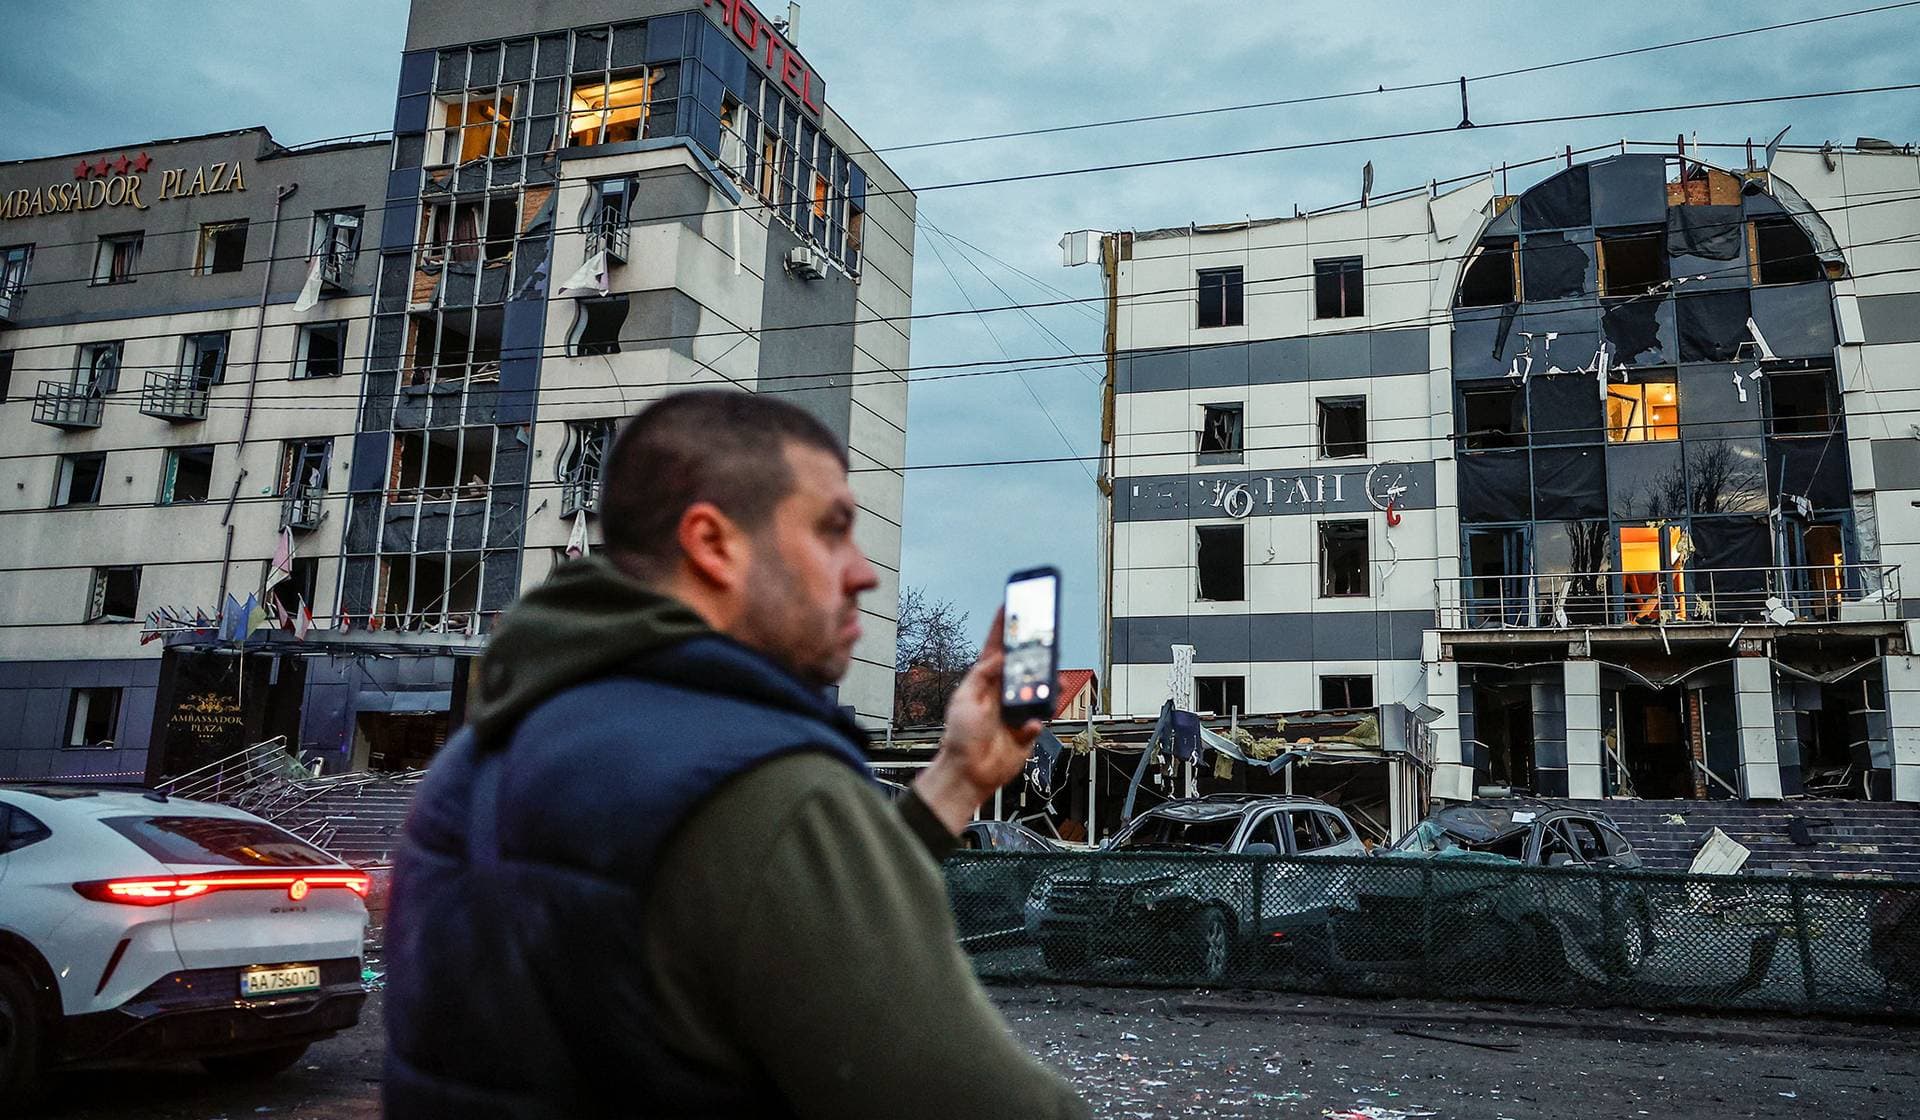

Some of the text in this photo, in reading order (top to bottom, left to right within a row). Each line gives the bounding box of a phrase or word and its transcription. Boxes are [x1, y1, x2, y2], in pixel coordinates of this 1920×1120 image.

[158, 161, 247, 200] PLAZA
[171, 714, 244, 726] AMBASSADOR
[191, 724, 223, 732] PLAZA
[250, 974, 268, 991] AA
[271, 972, 299, 988] 7560
